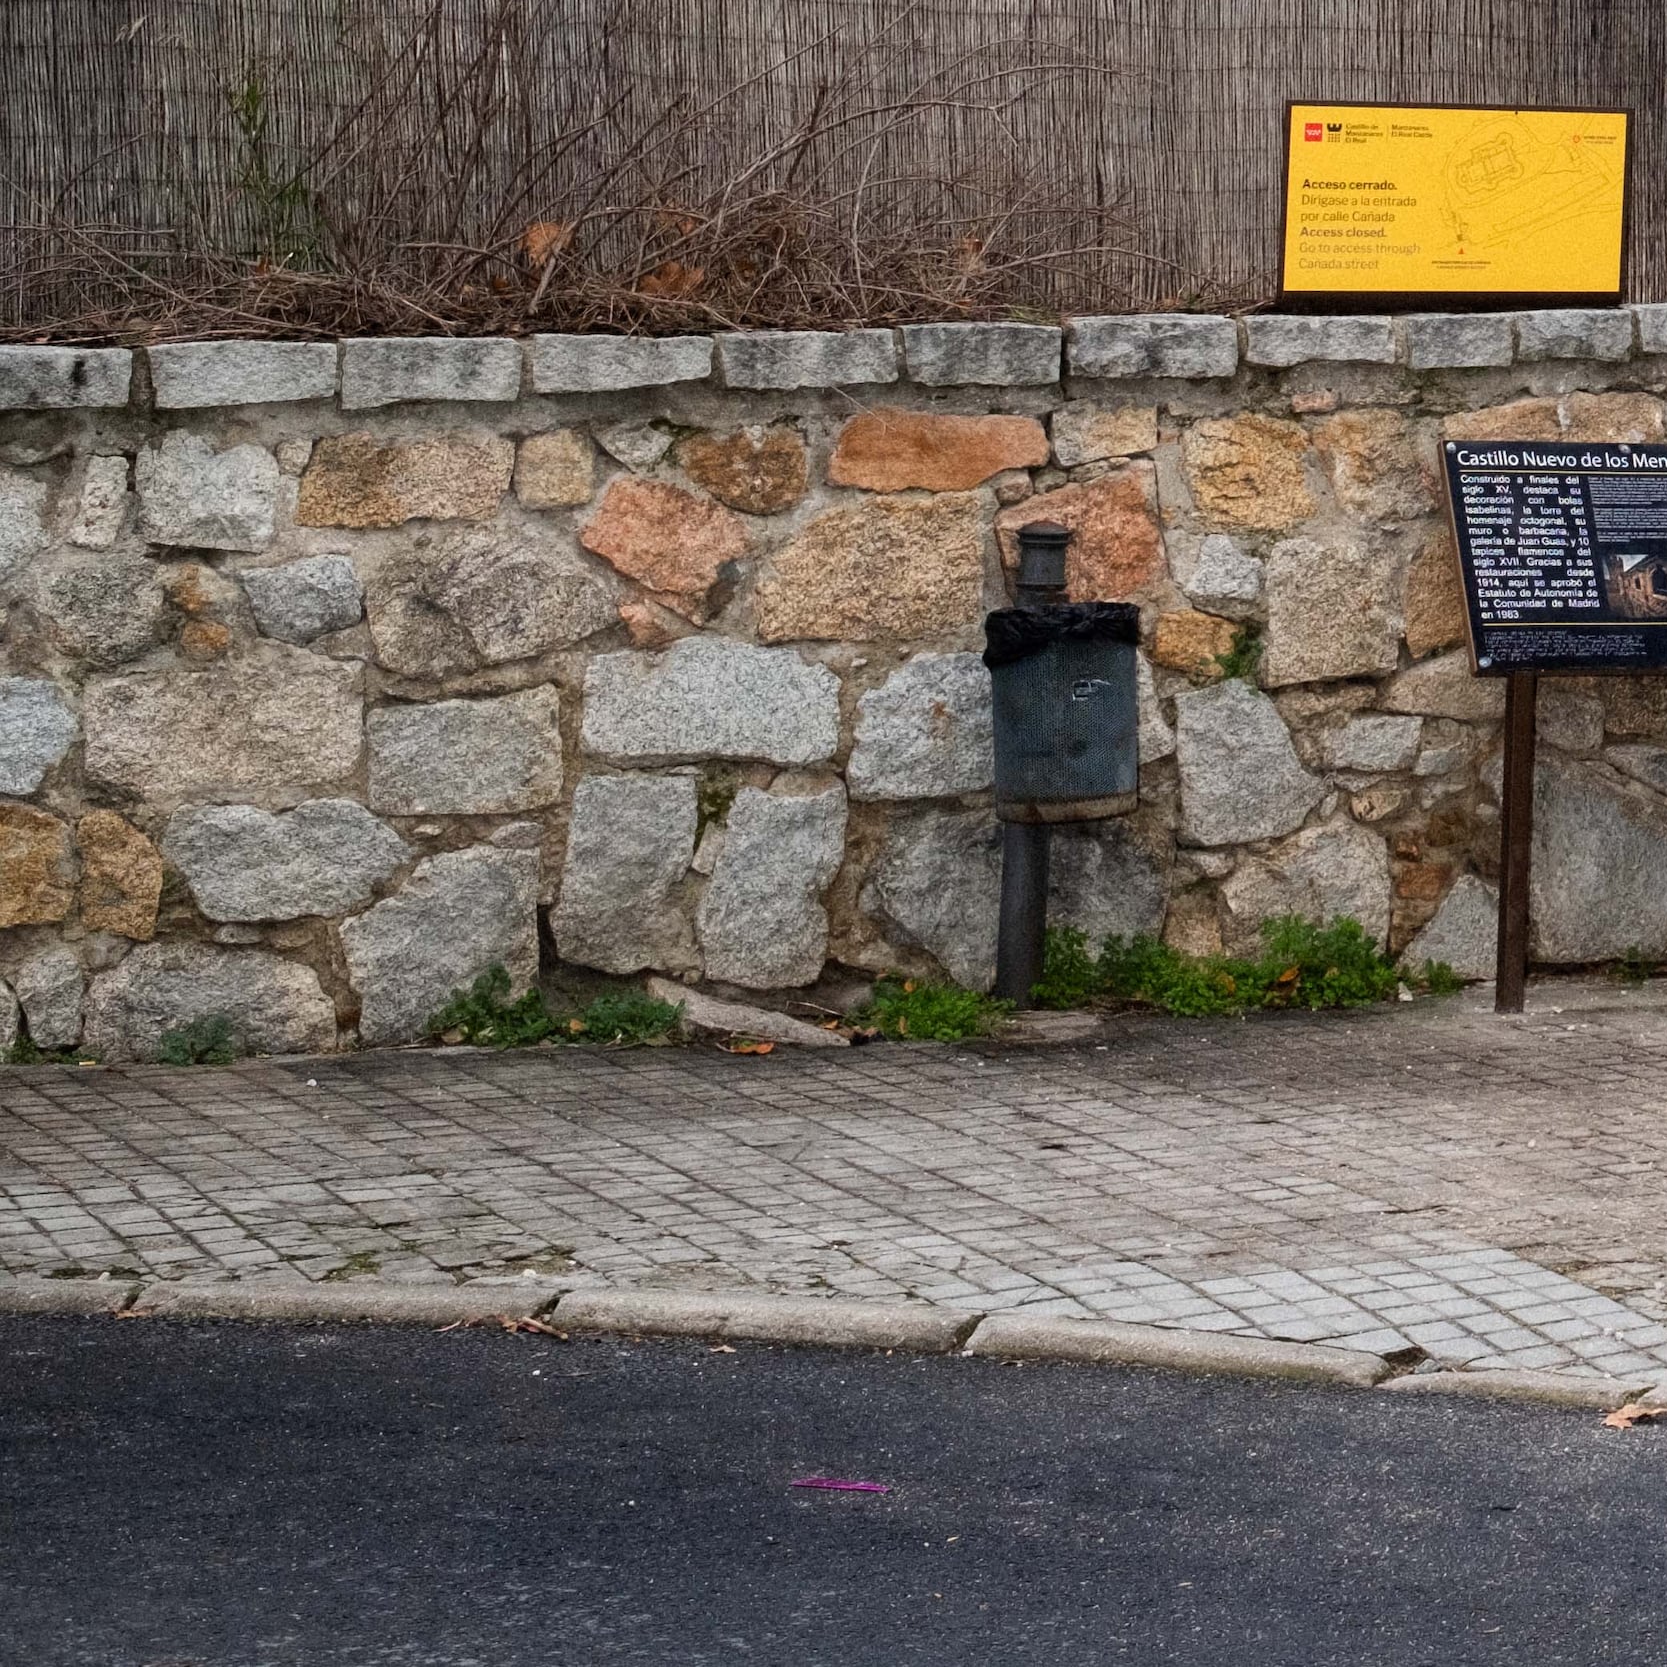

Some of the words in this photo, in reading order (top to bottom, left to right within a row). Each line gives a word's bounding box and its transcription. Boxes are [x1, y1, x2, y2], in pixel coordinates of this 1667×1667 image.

[1302, 179, 1346, 190] Acceso
[1349, 180, 1397, 190] cerrado.
[1351, 198, 1357, 206] a
[1361, 196, 1370, 206] la
[1373, 196, 1417, 207] entrada
[1300, 213, 1319, 222] por
[1323, 211, 1349, 222] calle
[1300, 226, 1343, 237] Access
[1346, 227, 1388, 238] closed.
[1299, 242, 1316, 253] Go
[1319, 244, 1330, 253] to
[1333, 245, 1374, 254] access
[1376, 243, 1420, 255] through
[1345, 260, 1379, 269] street
[1457, 450, 1519, 467] Castillo
[1523, 452, 1577, 467] Nuevo
[1581, 453, 1602, 468] de
[1605, 452, 1629, 468] los
[1460, 475, 1510, 483] Construido
[1529, 475, 1559, 484] finales
[1565, 476, 1580, 484] del
[1462, 485, 1484, 496] siglo
[1523, 486, 1559, 494] destaca
[1463, 495, 1514, 504] decoración
[1558, 496, 1583, 505] bolas
[1523, 506, 1532, 514] la
[1540, 507, 1562, 515] torre
[1570, 507, 1584, 515] del
[1467, 516, 1512, 526] homenaje
[1520, 516, 1567, 527] octogonal,
[1575, 518, 1586, 526] su
[1519, 527, 1570, 536] barbacana,
[1579, 527, 1588, 536] la
[1470, 537, 1502, 547] galería
[1504, 537, 1516, 545] de
[1518, 537, 1540, 546] Juan
[1542, 537, 1569, 546] Guas,
[1578, 537, 1589, 546] 10
[1472, 548, 1505, 557] tapices
[1518, 547, 1564, 556] flamencos
[1577, 548, 1591, 556] del
[1473, 557, 1495, 568] siglo
[1527, 557, 1562, 566] Gracias
[1475, 568, 1542, 577] restauraciones
[1567, 569, 1594, 577] desde
[1551, 579, 1583, 588] aprobó
[1588, 578, 1596, 587] el
[1478, 589, 1516, 598] Estatuto
[1519, 589, 1532, 597] de
[1534, 588, 1583, 597] Autonomía
[1586, 589, 1598, 597] de
[1480, 599, 1488, 608] la
[1494, 599, 1546, 608] Comunidad
[1552, 599, 1564, 608] de
[1568, 599, 1600, 608] Madrid
